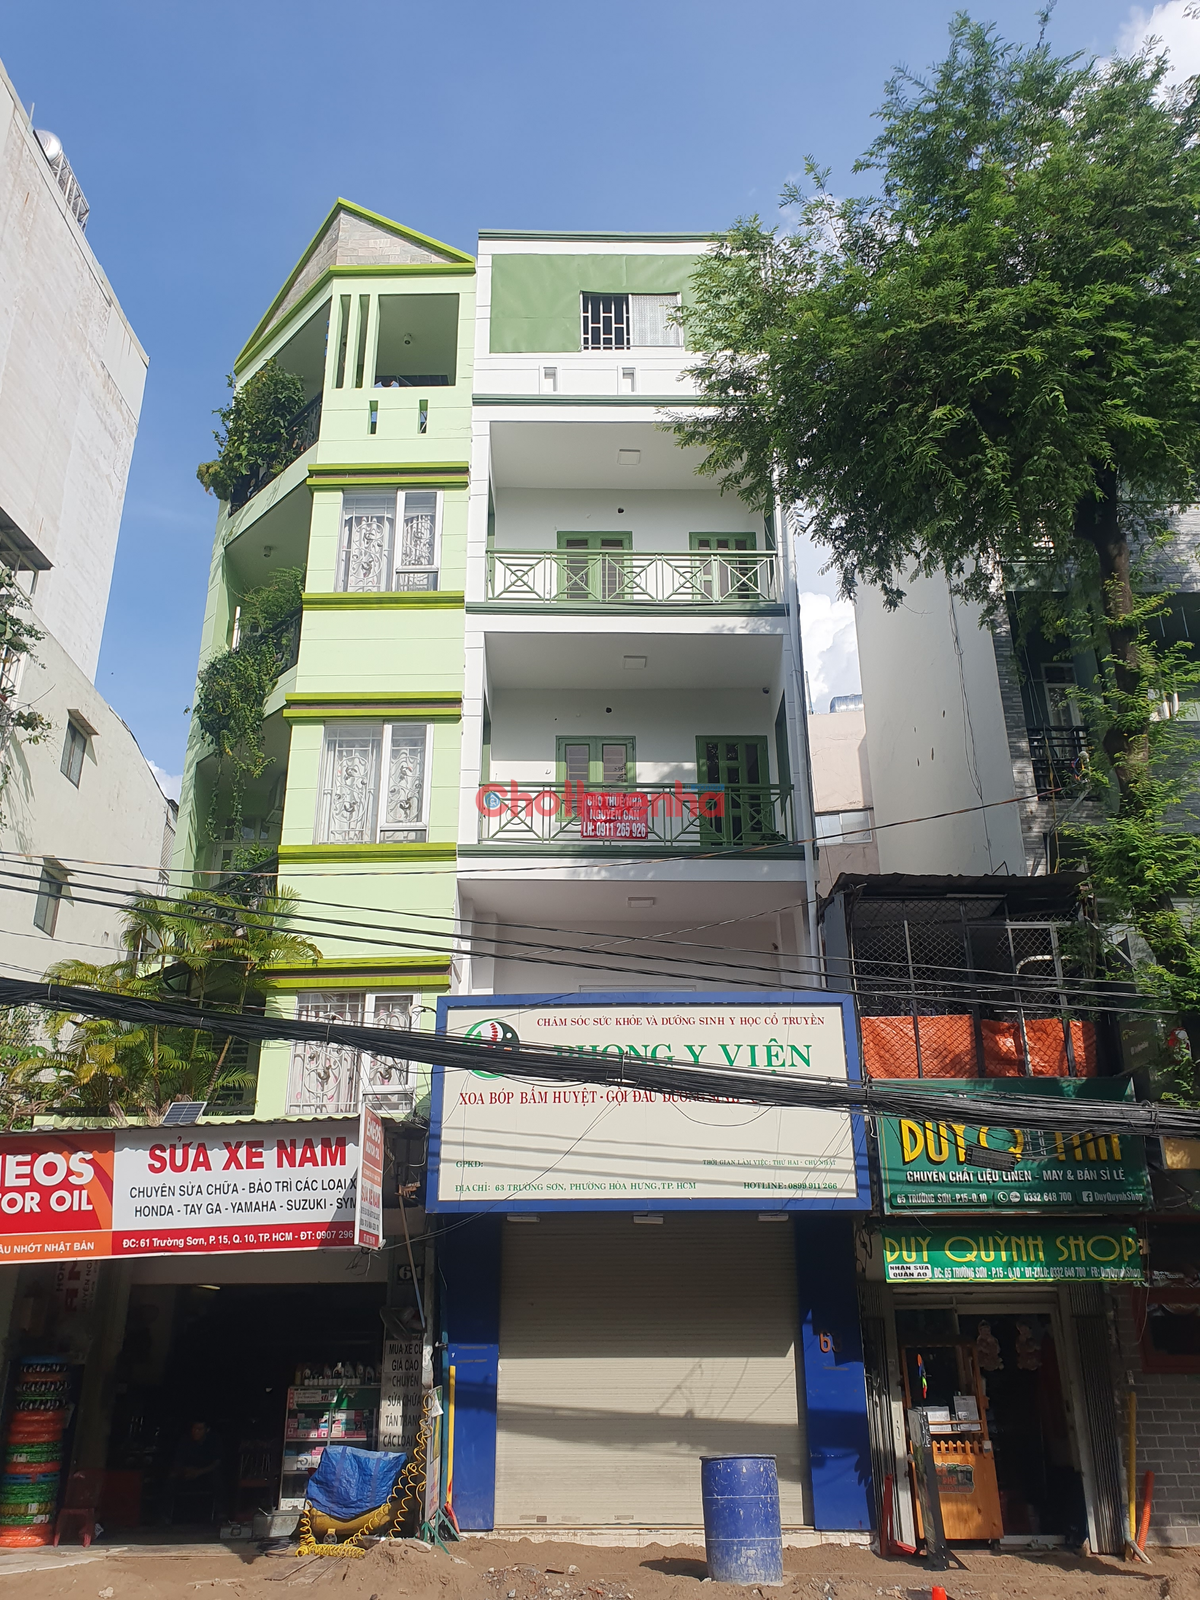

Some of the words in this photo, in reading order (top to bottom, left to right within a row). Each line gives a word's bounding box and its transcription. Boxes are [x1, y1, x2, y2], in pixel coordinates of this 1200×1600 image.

[587, 795, 602, 806] CHO
[596, 822, 614, 837] 0911
[616, 822, 630, 837] 265
[632, 823, 646, 838] 926
[537, 1015, 567, 1027] CHĂM
[570, 1014, 590, 1026] SÓC
[592, 1014, 612, 1026] SỨC
[616, 1014, 643, 1026] KHỎE
[646, 1014, 658, 1026] VÀ
[661, 1014, 696, 1026] DƯỠNG
[699, 1016, 725, 1026] SINH
[729, 1016, 736, 1026] Y
[740, 1016, 762, 1027] HỌC
[764, 1012, 778, 1026] CỔ
[782, 1012, 825, 1026] TRUYỀN
[684, 1044, 708, 1066] Y
[718, 1037, 812, 1074] VIỆN
[459, 1092, 485, 1106] XOA
[490, 1087, 514, 1104] BÓP
[520, 1086, 548, 1104] BẤM
[552, 1088, 597, 1106] HUYỆT
[606, 1087, 628, 1106] GỘI
[900, 1119, 968, 1163] DUY
[148, 1136, 212, 1174] SỬA
[222, 1140, 264, 1170] XE
[276, 1136, 346, 1168] NAM
[737, 1158, 752, 1166] LÀM
[0, 1151, 95, 1187] EOS
[456, 1160, 484, 1168] GPKD:
[906, 1169, 946, 1182] CHUYÊN
[949, 1167, 974, 1182] CHẤT
[978, 1168, 999, 1184] LIỆU
[1002, 1170, 1032, 1181] LINEN
[1043, 1170, 1064, 1180] MAY
[1066, 1170, 1074, 1180] &
[1077, 1168, 1098, 1180] BÁN
[130, 1182, 176, 1198] CHUYÊN
[178, 1181, 204, 1196] SỬA
[206, 1180, 239, 1195] CHỮA
[248, 1178, 272, 1194] BẢO
[274, 1178, 292, 1192] TRÌ
[296, 1177, 318, 1192] CÁC
[322, 1178, 346, 1193] LOẠI
[455, 1184, 470, 1194] ĐỊA
[472, 1182, 491, 1192] CHỈ:
[494, 1184, 504, 1192] 63
[507, 1182, 544, 1192] TRƯỜNG
[546, 1183, 566, 1192] SƠN,
[570, 1181, 606, 1190] PHƯỜNG
[609, 1180, 626, 1190] HÒA
[676, 1182, 696, 1190] HCM
[744, 1182, 786, 1190] HOTLINE:
[788, 1182, 806, 1190] 0899
[808, 1182, 820, 1190] 911
[823, 1182, 838, 1190] 266
[0, 1191, 41, 1214] OR
[50, 1190, 94, 1212] OIL
[896, 1194, 906, 1204] 65
[1024, 1192, 1042, 1202] 0332
[1044, 1192, 1057, 1202] 648
[1060, 1192, 1072, 1202] 700
[134, 1204, 174, 1218] HONDA
[184, 1204, 203, 1216] TAY
[206, 1202, 222, 1214] GA
[230, 1200, 276, 1213] YAMAHA
[286, 1198, 326, 1211] SUZUKI
[122, 1238, 139, 1248] ĐC:
[140, 1238, 150, 1248] 61
[152, 1237, 184, 1248] Trường
[186, 1236, 207, 1246] Sơn,
[209, 1236, 216, 1244] P.
[218, 1235, 230, 1244] 15,
[232, 1234, 242, 1243] Q.
[244, 1234, 256, 1244] 10,
[258, 1233, 270, 1242] TP.
[272, 1232, 292, 1241] HCM
[300, 1232, 315, 1240] ĐT:
[316, 1230, 336, 1240] 0907
[338, 1230, 354, 1238] 296
[884, 1236, 932, 1262] DUY
[944, 1230, 1044, 1262] QUỲNH
[1056, 1235, 1136, 1262] SHOP
[14, 1243, 42, 1253] NHỚT
[44, 1242, 72, 1254] NHẬT
[74, 1240, 94, 1250] BẢN
[398, 1265, 424, 1280] 61
[389, 1344, 403, 1354] MUA
[404, 1344, 412, 1354] XE
[405, 1360, 419, 1371] CAO
[383, 1433, 396, 1447] CÁC
